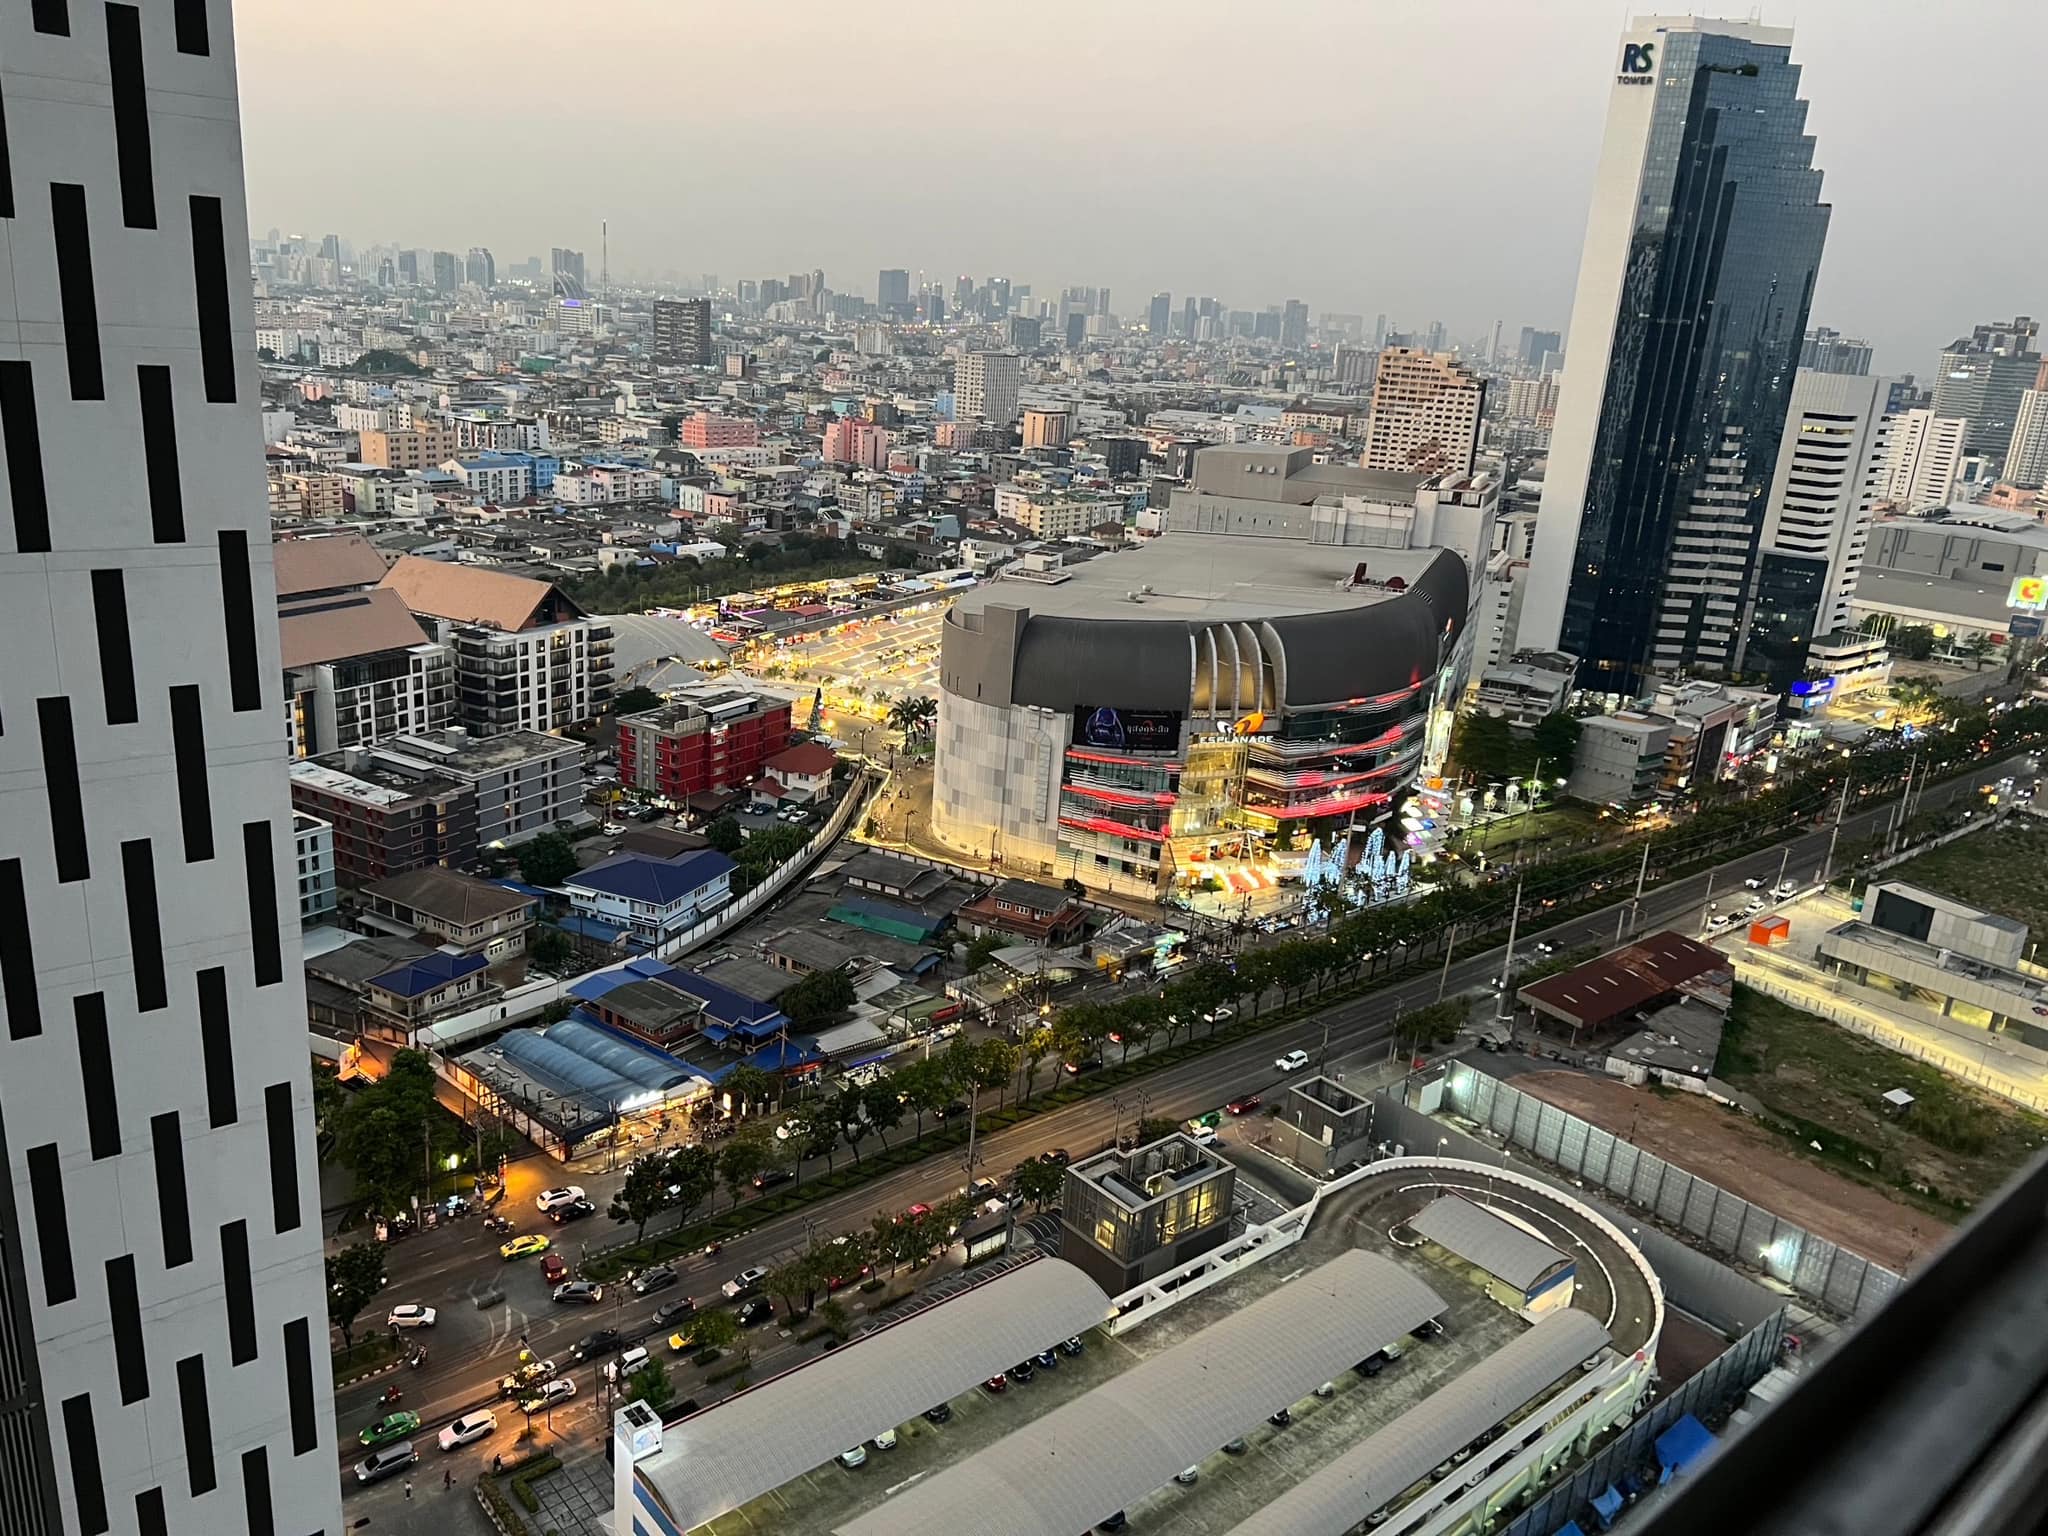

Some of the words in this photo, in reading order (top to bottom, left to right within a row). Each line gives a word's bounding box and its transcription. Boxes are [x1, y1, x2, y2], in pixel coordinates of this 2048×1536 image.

[1622, 43, 1654, 73] RS
[1617, 75, 1653, 85] TOWER
[1199, 735, 1274, 744] ESPLANADE
